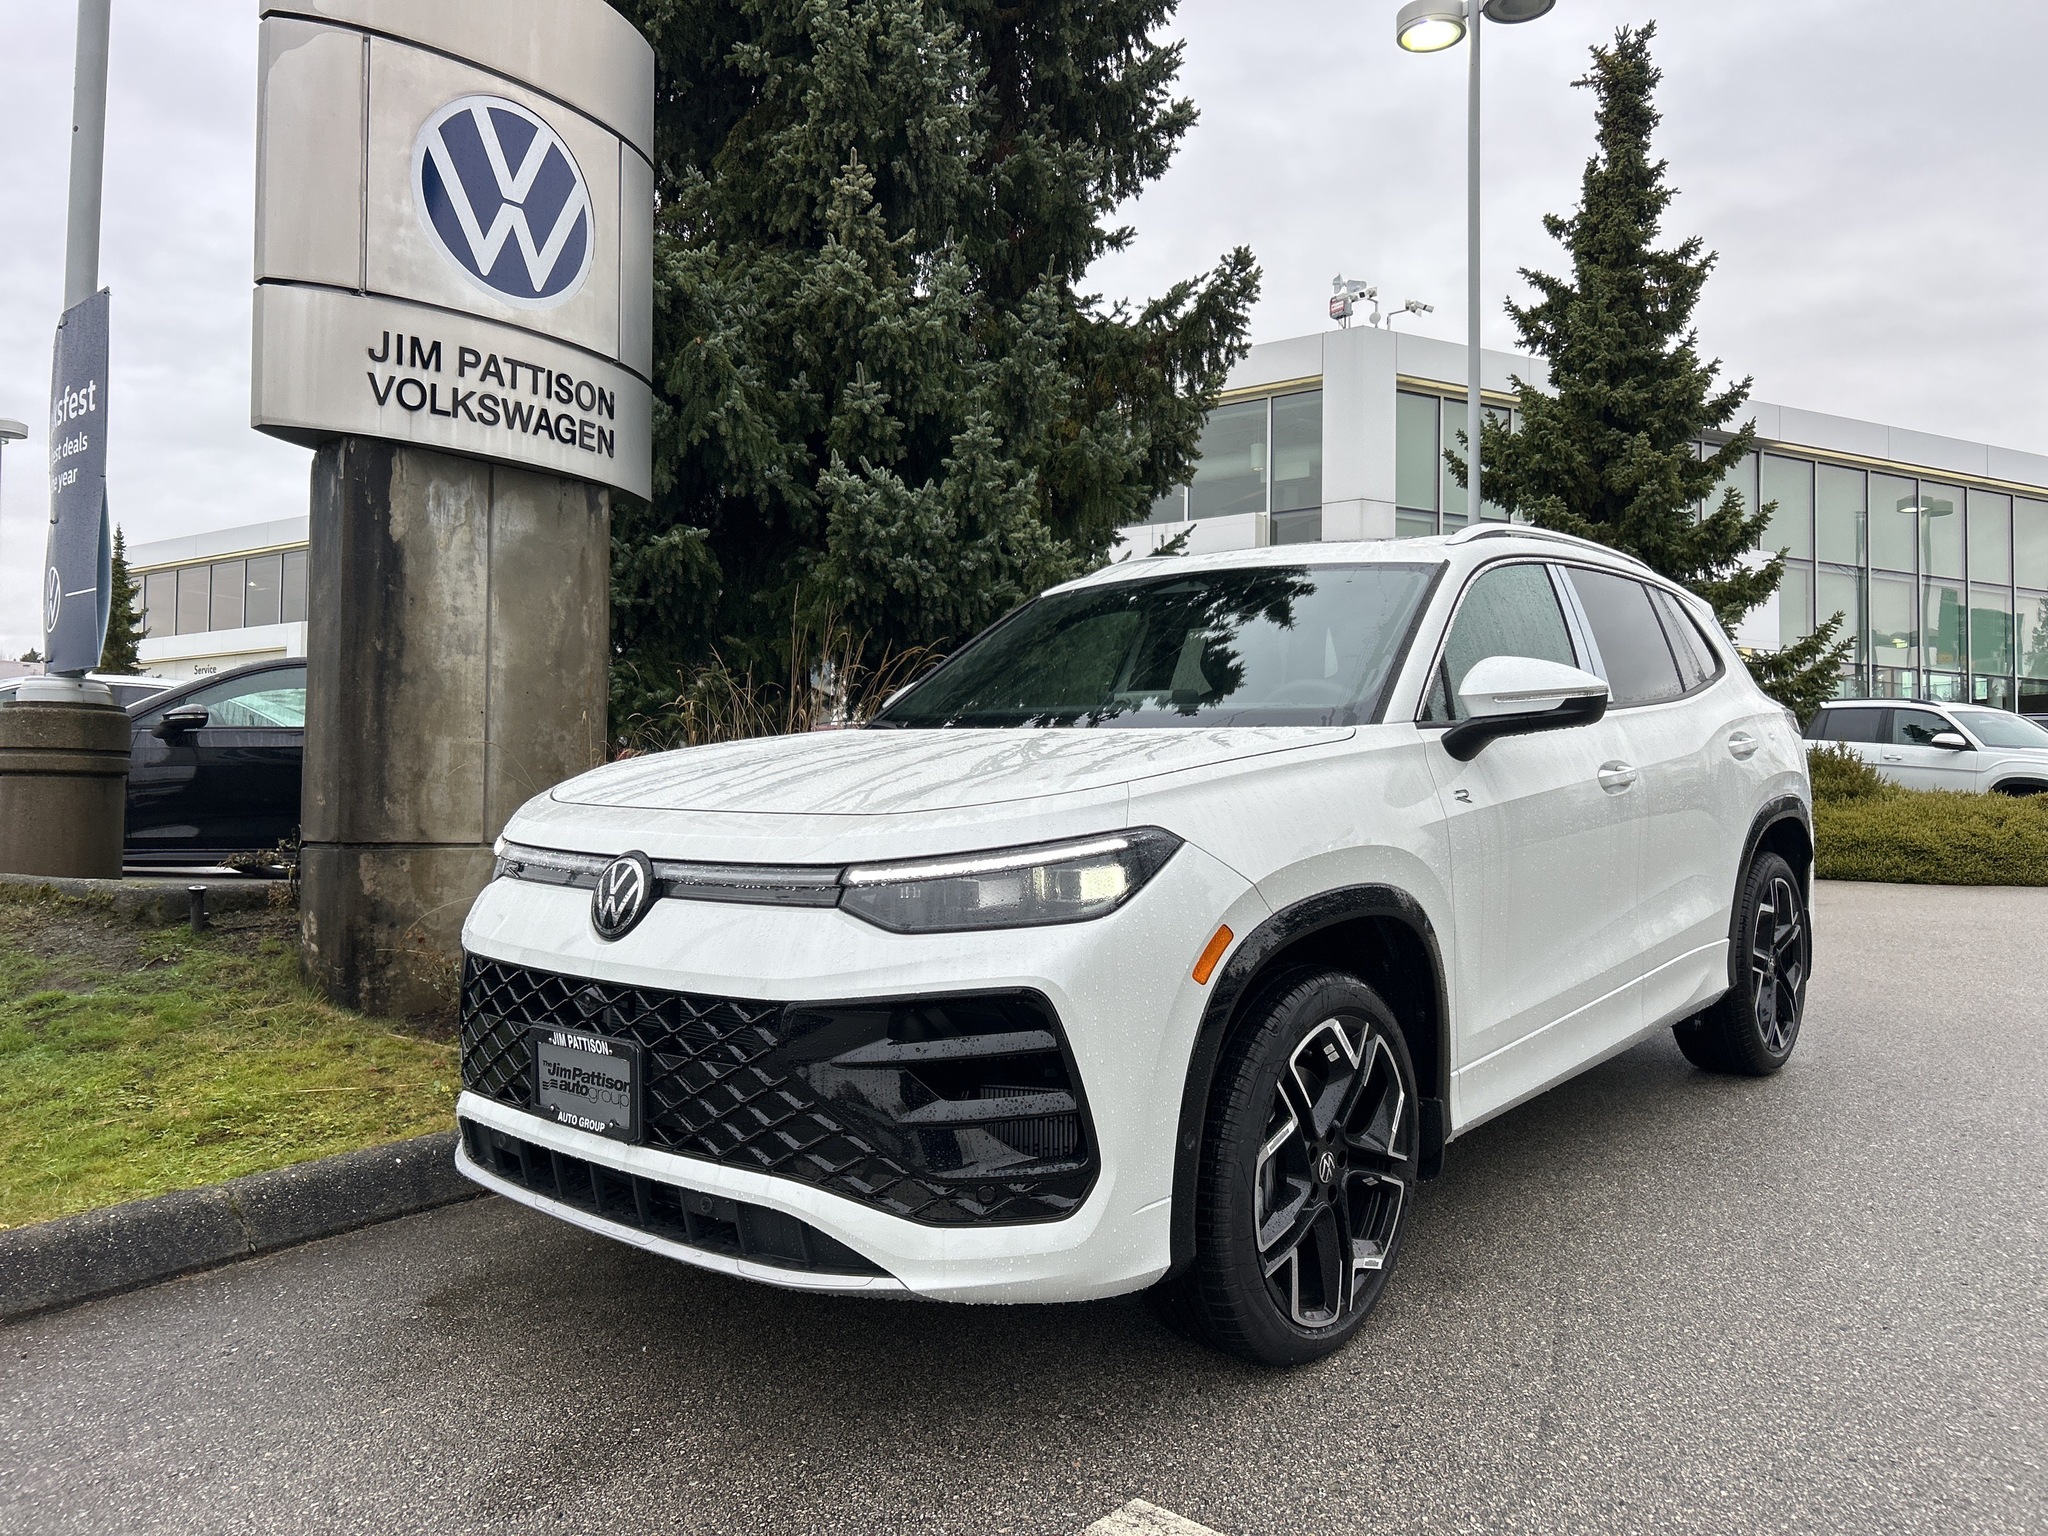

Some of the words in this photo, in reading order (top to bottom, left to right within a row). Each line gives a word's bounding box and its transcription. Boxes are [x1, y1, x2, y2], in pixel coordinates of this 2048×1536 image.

[368, 331, 442, 372] JIM
[458, 346, 615, 420] PATTISON
[367, 372, 615, 458] VOLKSWAGEN
[62, 431, 88, 458] deals
[58, 467, 78, 493] year
[194, 664, 217, 675] Service
[552, 1031, 567, 1047] JIM
[567, 1034, 609, 1056] PATTISON
[542, 1060, 552, 1068] The
[557, 1111, 578, 1126] AUTO
[578, 1116, 606, 1133] GROUP
